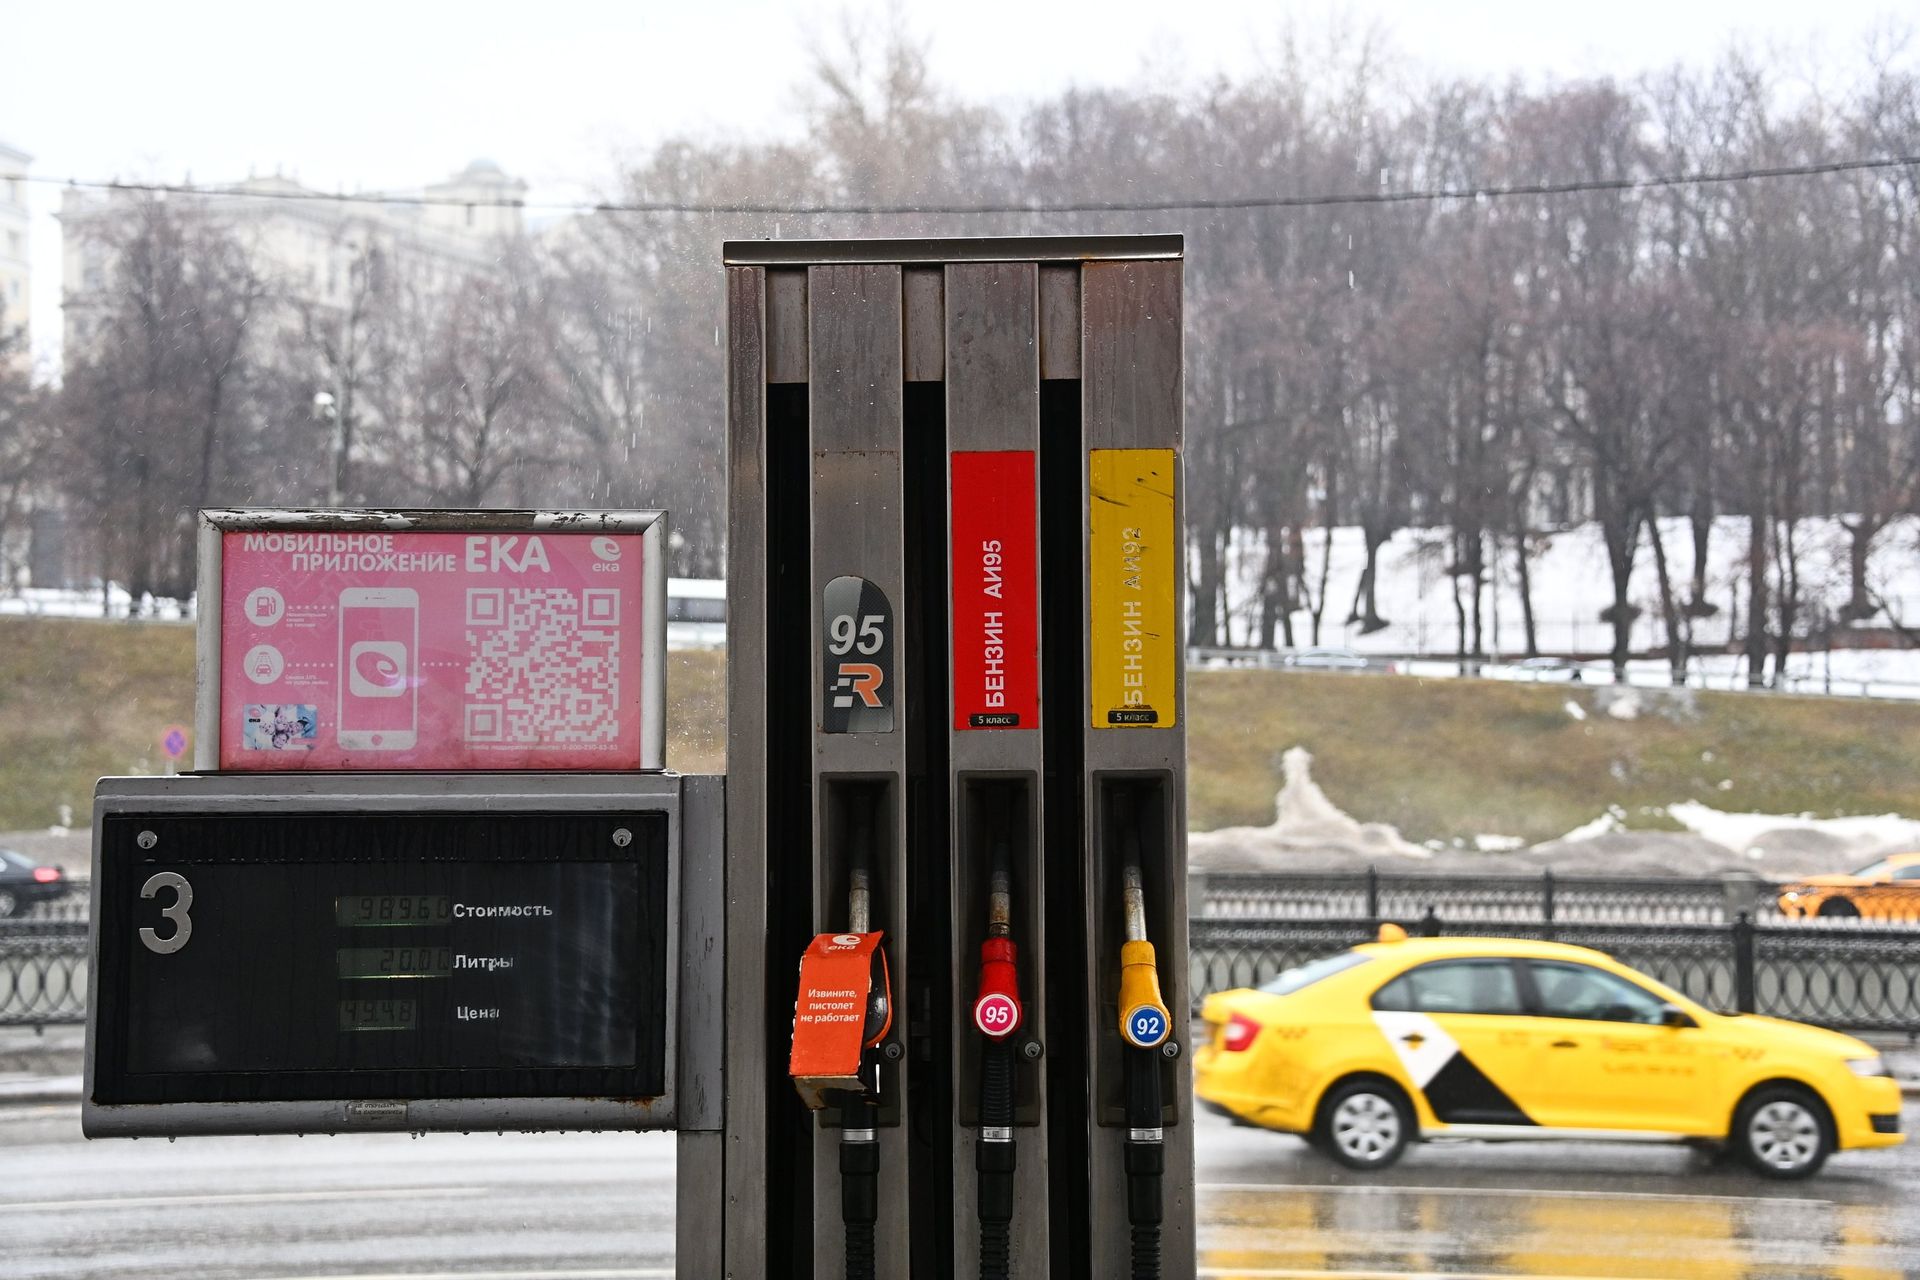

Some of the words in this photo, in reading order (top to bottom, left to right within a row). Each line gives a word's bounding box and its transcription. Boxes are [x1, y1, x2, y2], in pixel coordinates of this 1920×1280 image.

[244, 534, 394, 553] МОБИЛЬНОЕ
[292, 553, 457, 573] ПРИЛОЖЕНИЕ
[465, 536, 551, 573] ЕКА
[1122, 527, 1142, 590] АИ92
[983, 540, 1003, 599] АИ95
[828, 614, 885, 656] 95
[984, 612, 1005, 708] БЕНЗИН
[1123, 601, 1143, 706] БЕНЗИН
[978, 715, 984, 724] 5
[986, 717, 1012, 725] класс
[1116, 713, 1122, 721] 5
[1124, 714, 1150, 722] класс
[139, 871, 194, 955] 3
[453, 903, 553, 918] Стоимость
[453, 954, 514, 972] Литры
[808, 988, 858, 999] Извините,
[457, 1006, 500, 1021] Цена
[809, 1002, 855, 1010] пистолет
[985, 1006, 1009, 1024] 95
[800, 1014, 813, 1022] не
[815, 1012, 860, 1024] работает
[1136, 1017, 1159, 1036] 92
